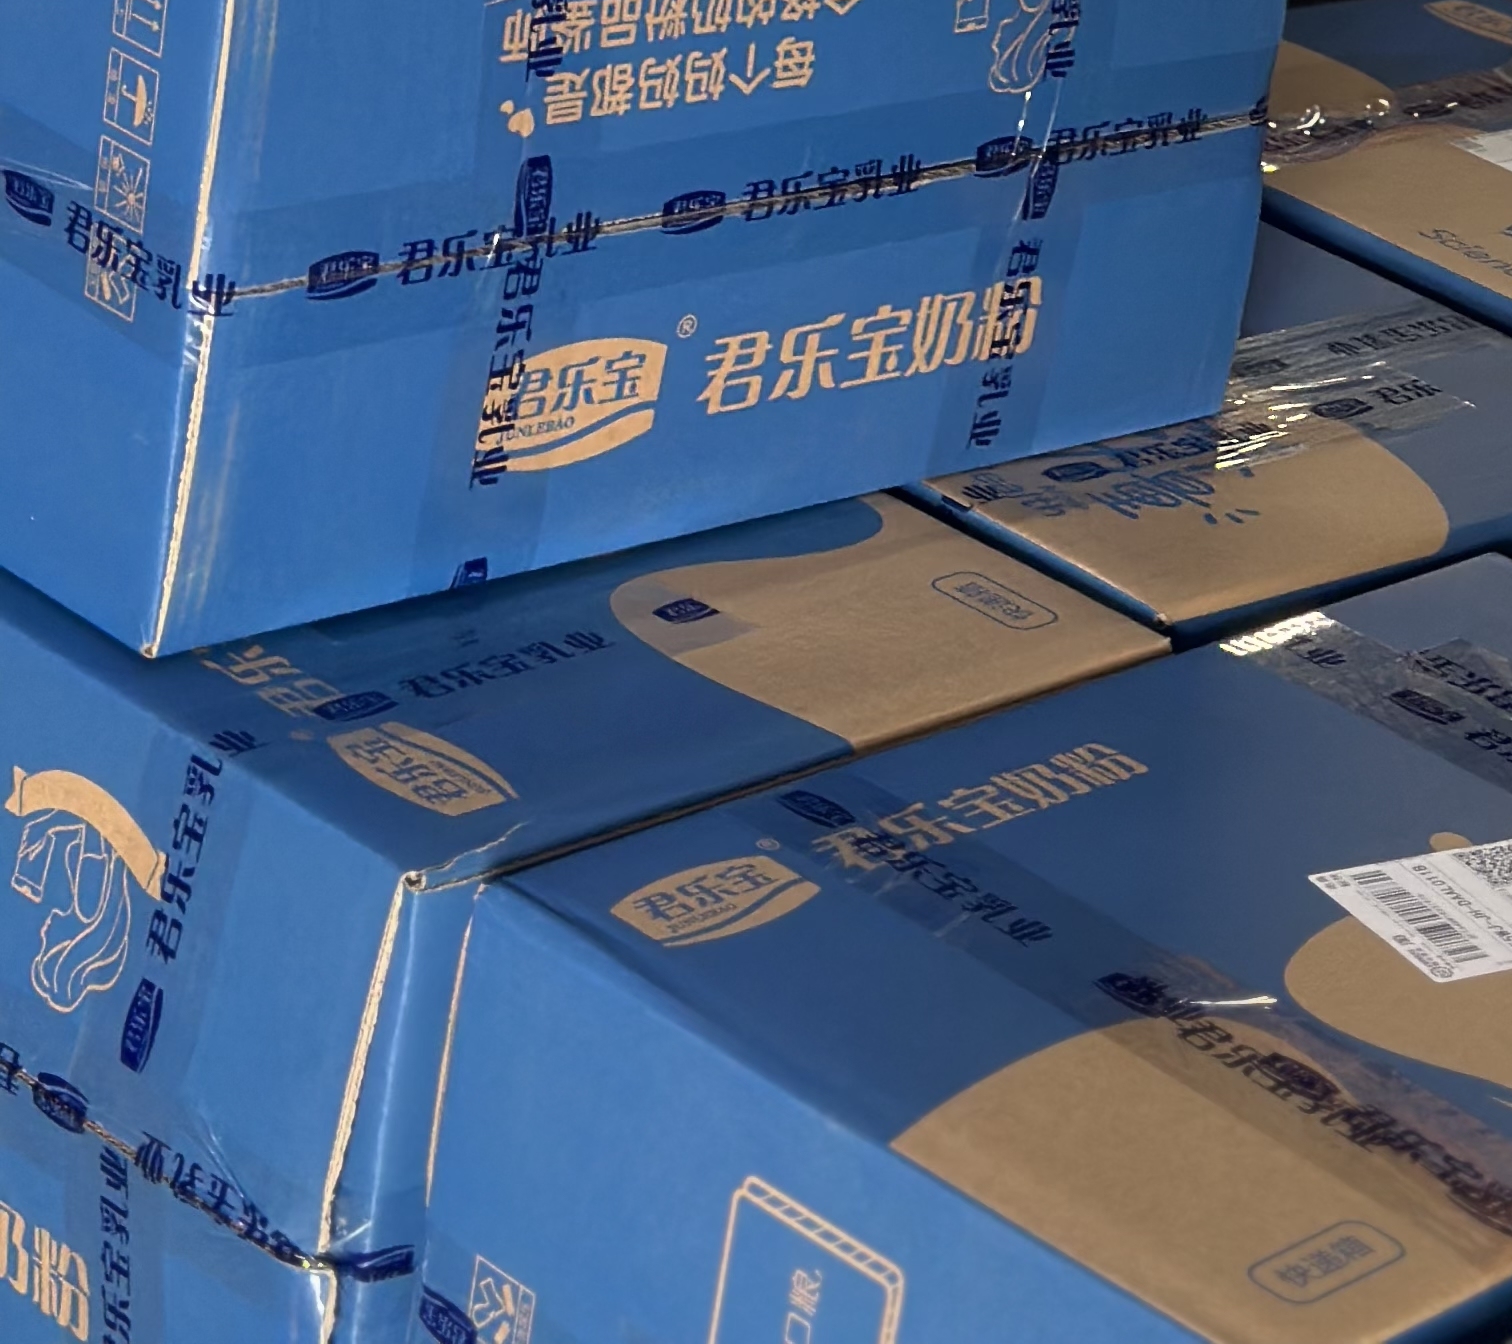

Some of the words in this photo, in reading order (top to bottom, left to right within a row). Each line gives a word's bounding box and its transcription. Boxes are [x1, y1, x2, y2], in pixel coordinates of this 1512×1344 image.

[543, 35, 815, 126] 每个妈妈都是
[512, 350, 645, 422] 君乐宝
[696, 275, 1043, 416] 君乐宝奶粉
[147, 725, 259, 965] 君乐宝乳业
[812, 742, 1150, 871] 君乐宝奶粉
[632, 863, 775, 922] 君乐宝
[1274, 1234, 1374, 1289] 快递箱
